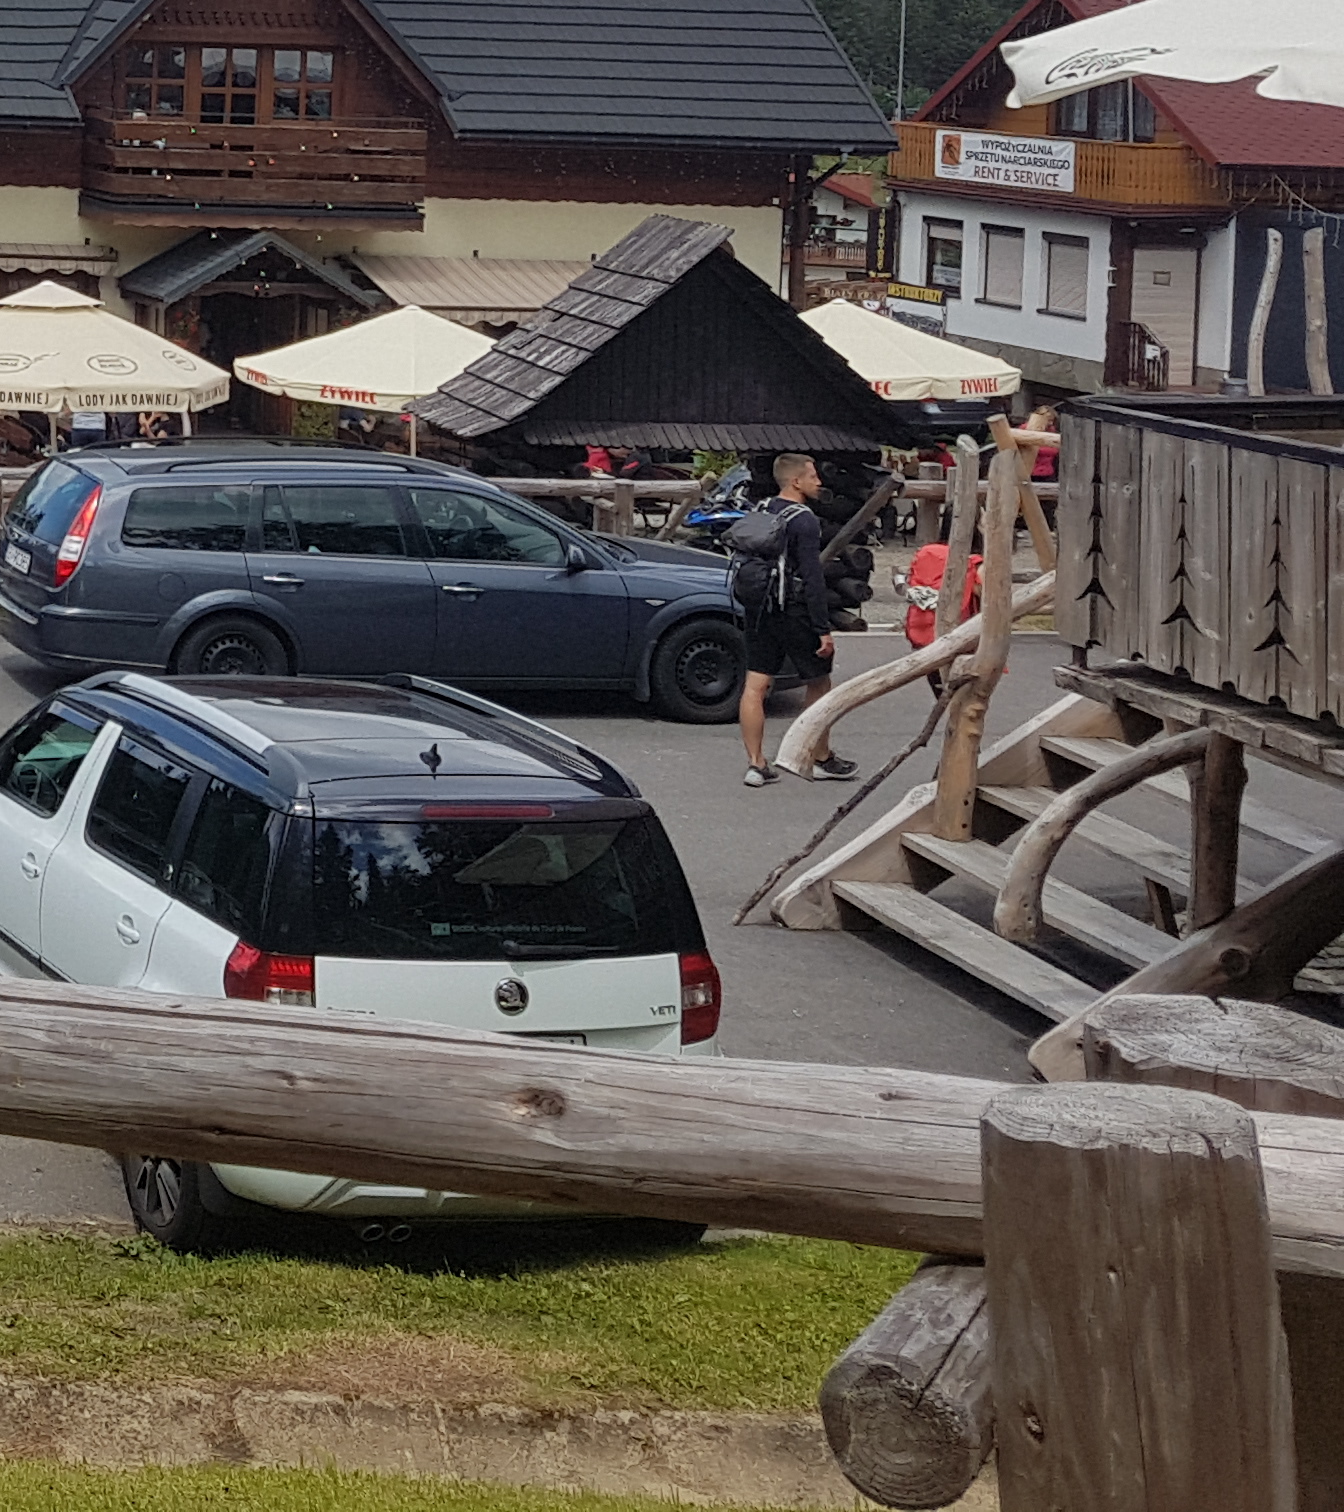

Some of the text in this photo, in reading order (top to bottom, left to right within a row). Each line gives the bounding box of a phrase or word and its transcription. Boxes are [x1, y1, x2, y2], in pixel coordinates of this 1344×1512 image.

[981, 139, 1053, 155] WYPOŻYCZALNIA
[974, 165, 1002, 180] RENT
[1003, 169, 1012, 181] &
[1013, 170, 1059, 187] SERVICE
[0, 391, 50, 405] DAWNIEJ
[78, 393, 179, 407] LODY JAK DAWNIEJ
